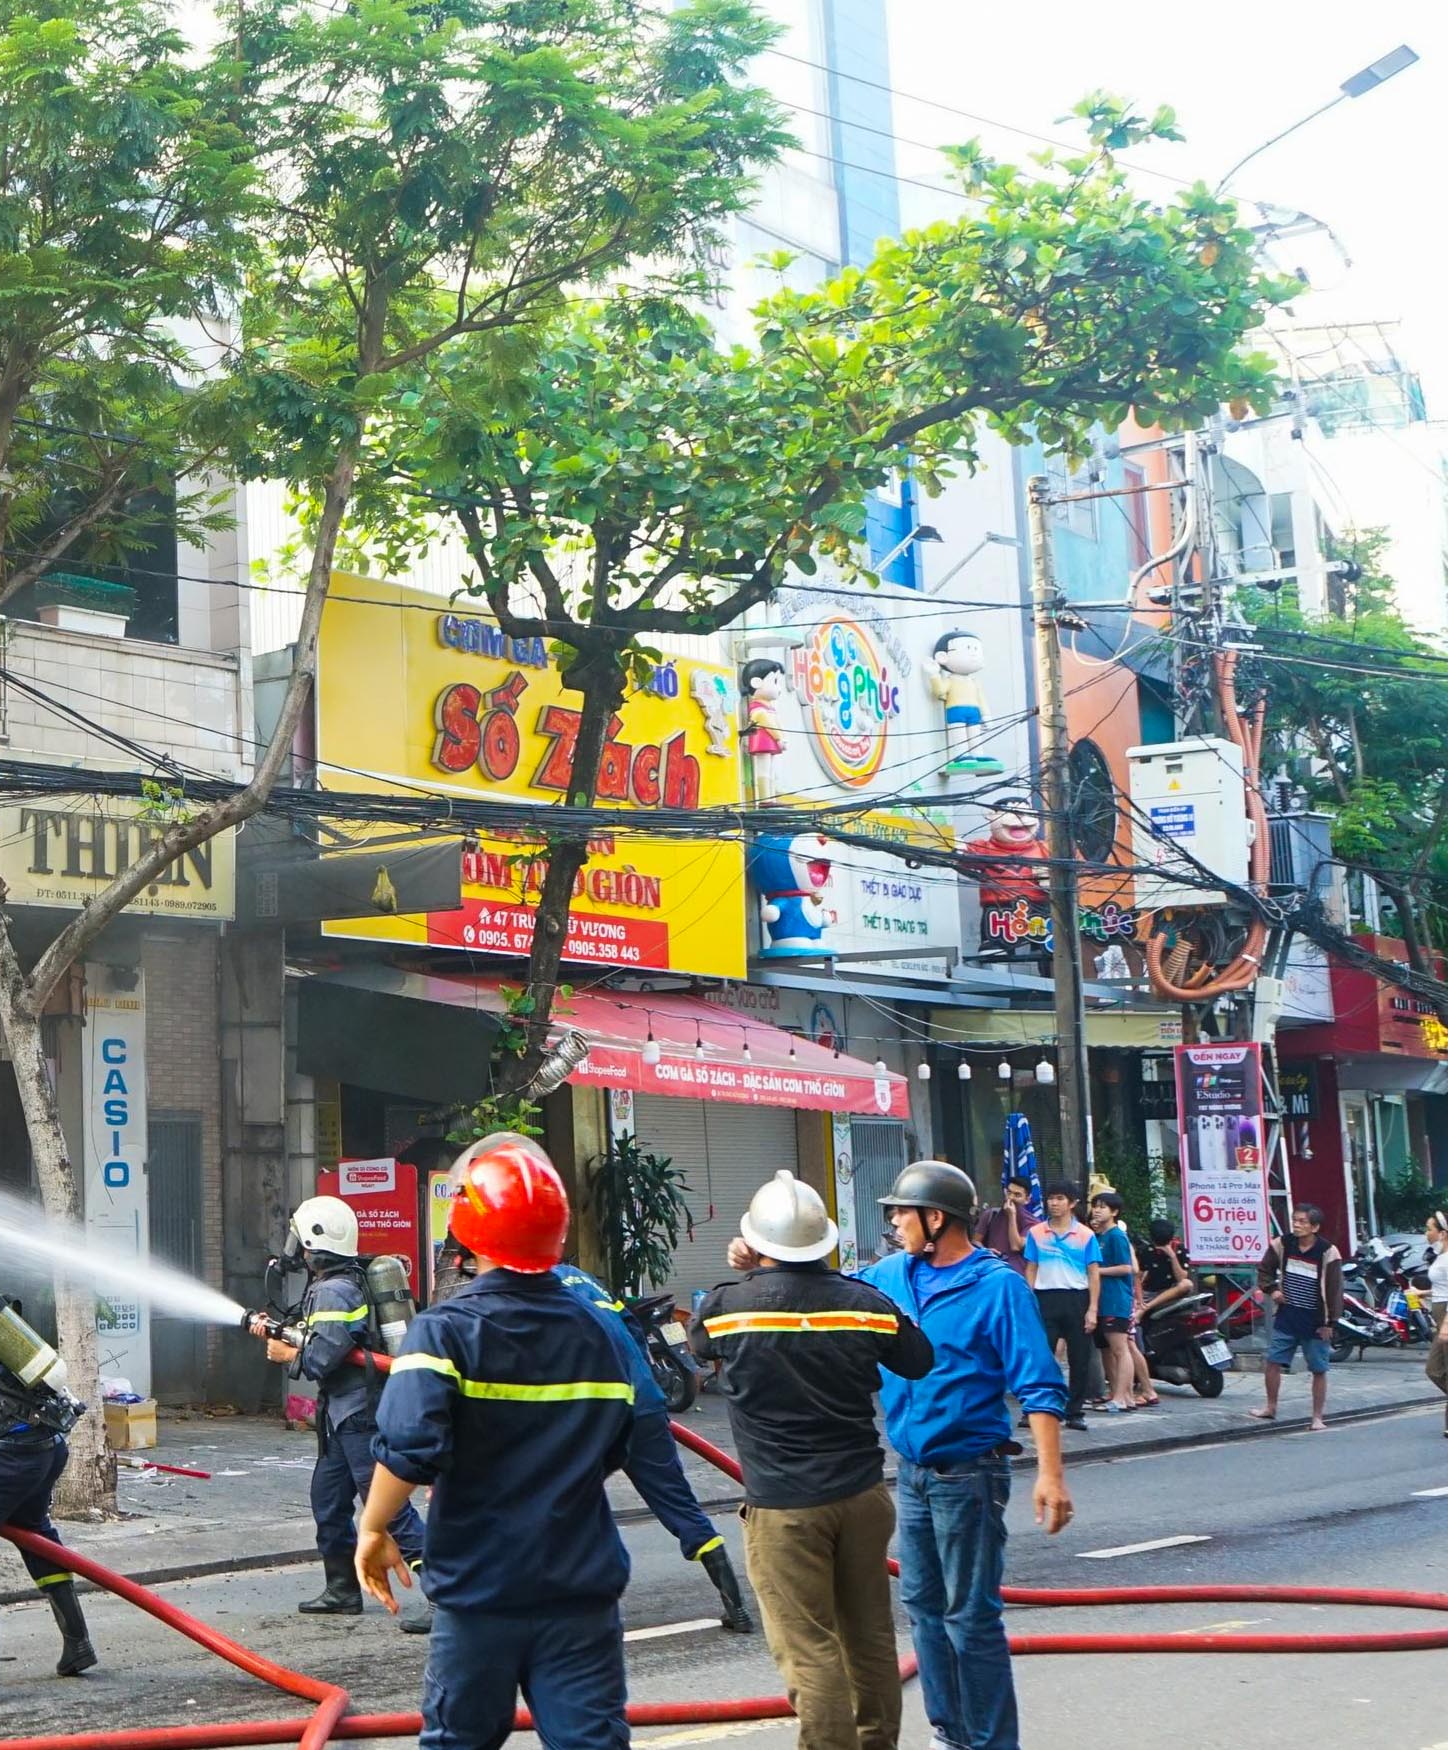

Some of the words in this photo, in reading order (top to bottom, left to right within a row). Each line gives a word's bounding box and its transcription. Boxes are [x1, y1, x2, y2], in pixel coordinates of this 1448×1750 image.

[792, 634, 853, 731] Hồng
[432, 671, 529, 782] Số
[529, 704, 701, 812] Zách
[20, 804, 212, 897] THIỆN
[463, 846, 512, 888] ƠM
[588, 864, 661, 908] GIÒN
[36, 888, 54, 899] ĐT:
[493, 910, 507, 927] 47
[580, 919, 626, 940] VƯƠNG
[568, 938, 618, 958] 0905.358
[620, 943, 640, 961] 443
[1215, 1051, 1242, 1061] NGAY
[588, 1062, 627, 1078] ShopeeFood
[710, 1067, 736, 1087] ZÁCH
[743, 1070, 762, 1092] ĐẶC
[823, 1078, 845, 1098] GIÒN
[102, 1038, 129, 1188] CASIO
[1292, 1093, 1310, 1114] Mi
[1243, 1147, 1254, 1161] 2
[1189, 1182, 1216, 1190] iPhone
[1244, 1181, 1261, 1189] Max
[380, 1210, 399, 1218] ZÁCH
[1193, 1195, 1214, 1223] 6
[1214, 1206, 1257, 1225] Triệu
[359, 1221, 376, 1229] CƠM
[392, 1219, 411, 1228] GIÒN
[1232, 1234, 1262, 1251] 0%
